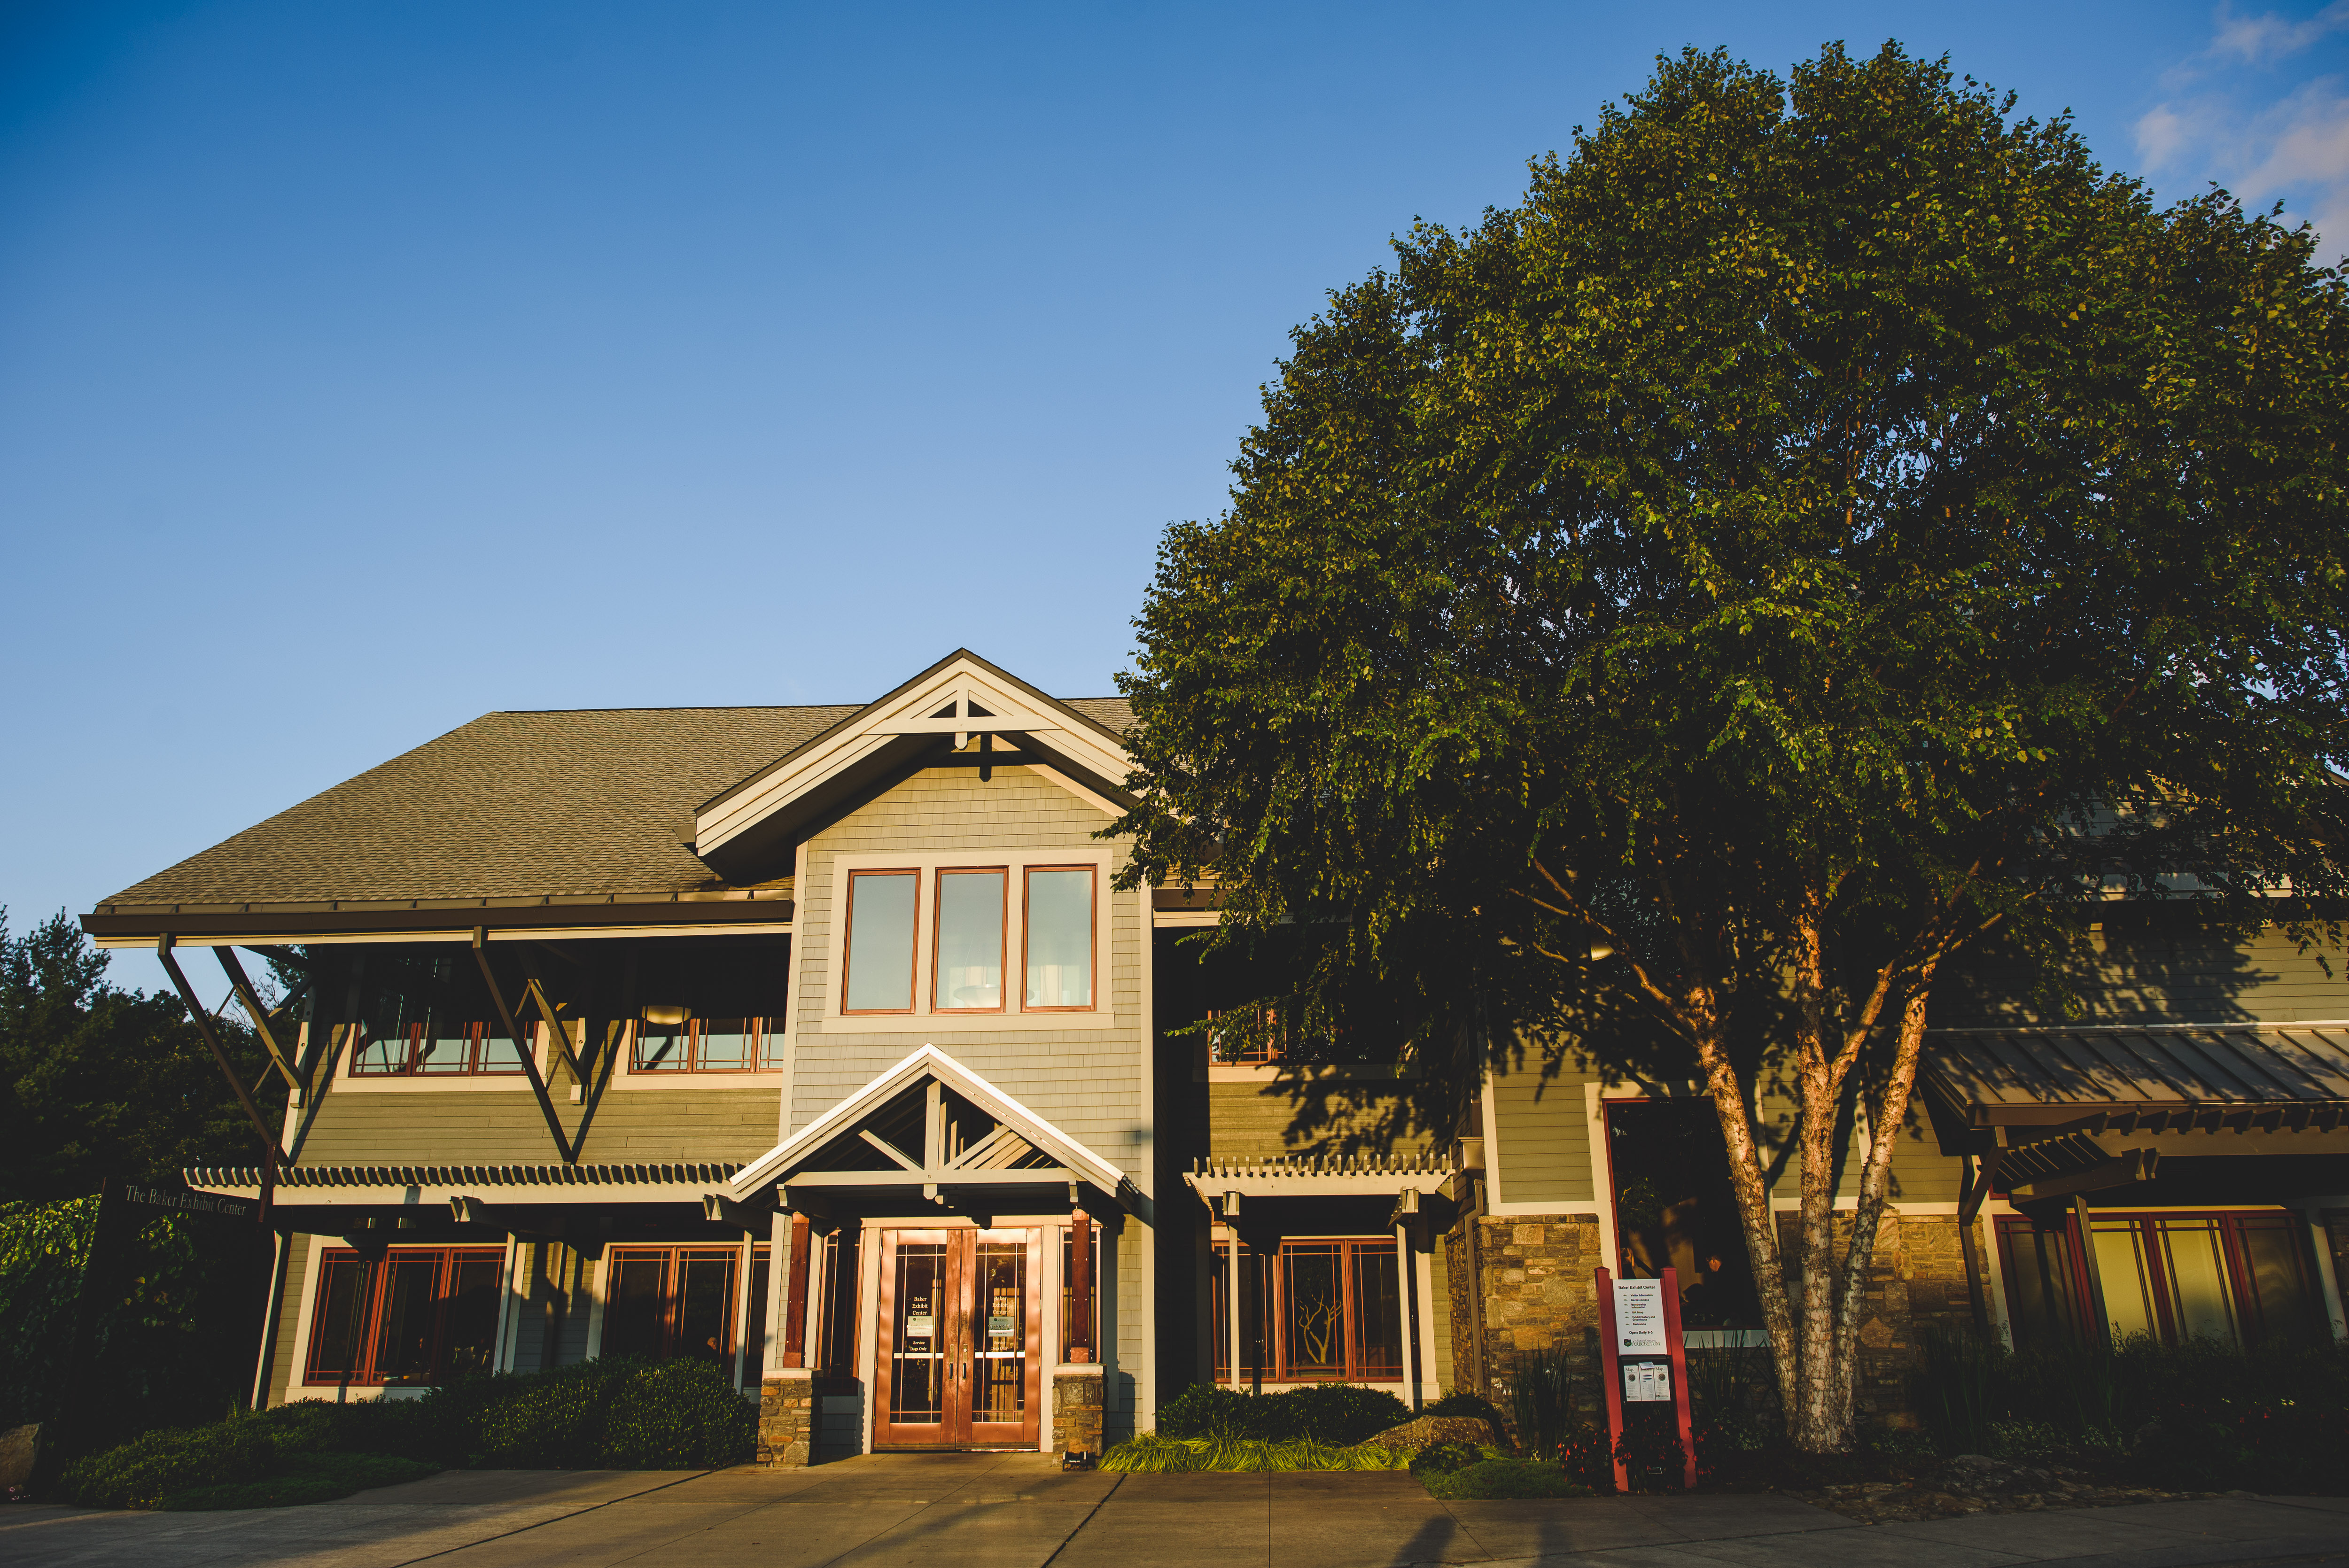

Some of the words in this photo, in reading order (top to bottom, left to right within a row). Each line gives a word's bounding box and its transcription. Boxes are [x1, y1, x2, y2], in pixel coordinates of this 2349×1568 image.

[126, 1184, 146, 1203] The
[149, 1188, 177, 1207] Baker
[179, 1193, 215, 1211] Exhibit
[218, 1198, 247, 1215] Center
